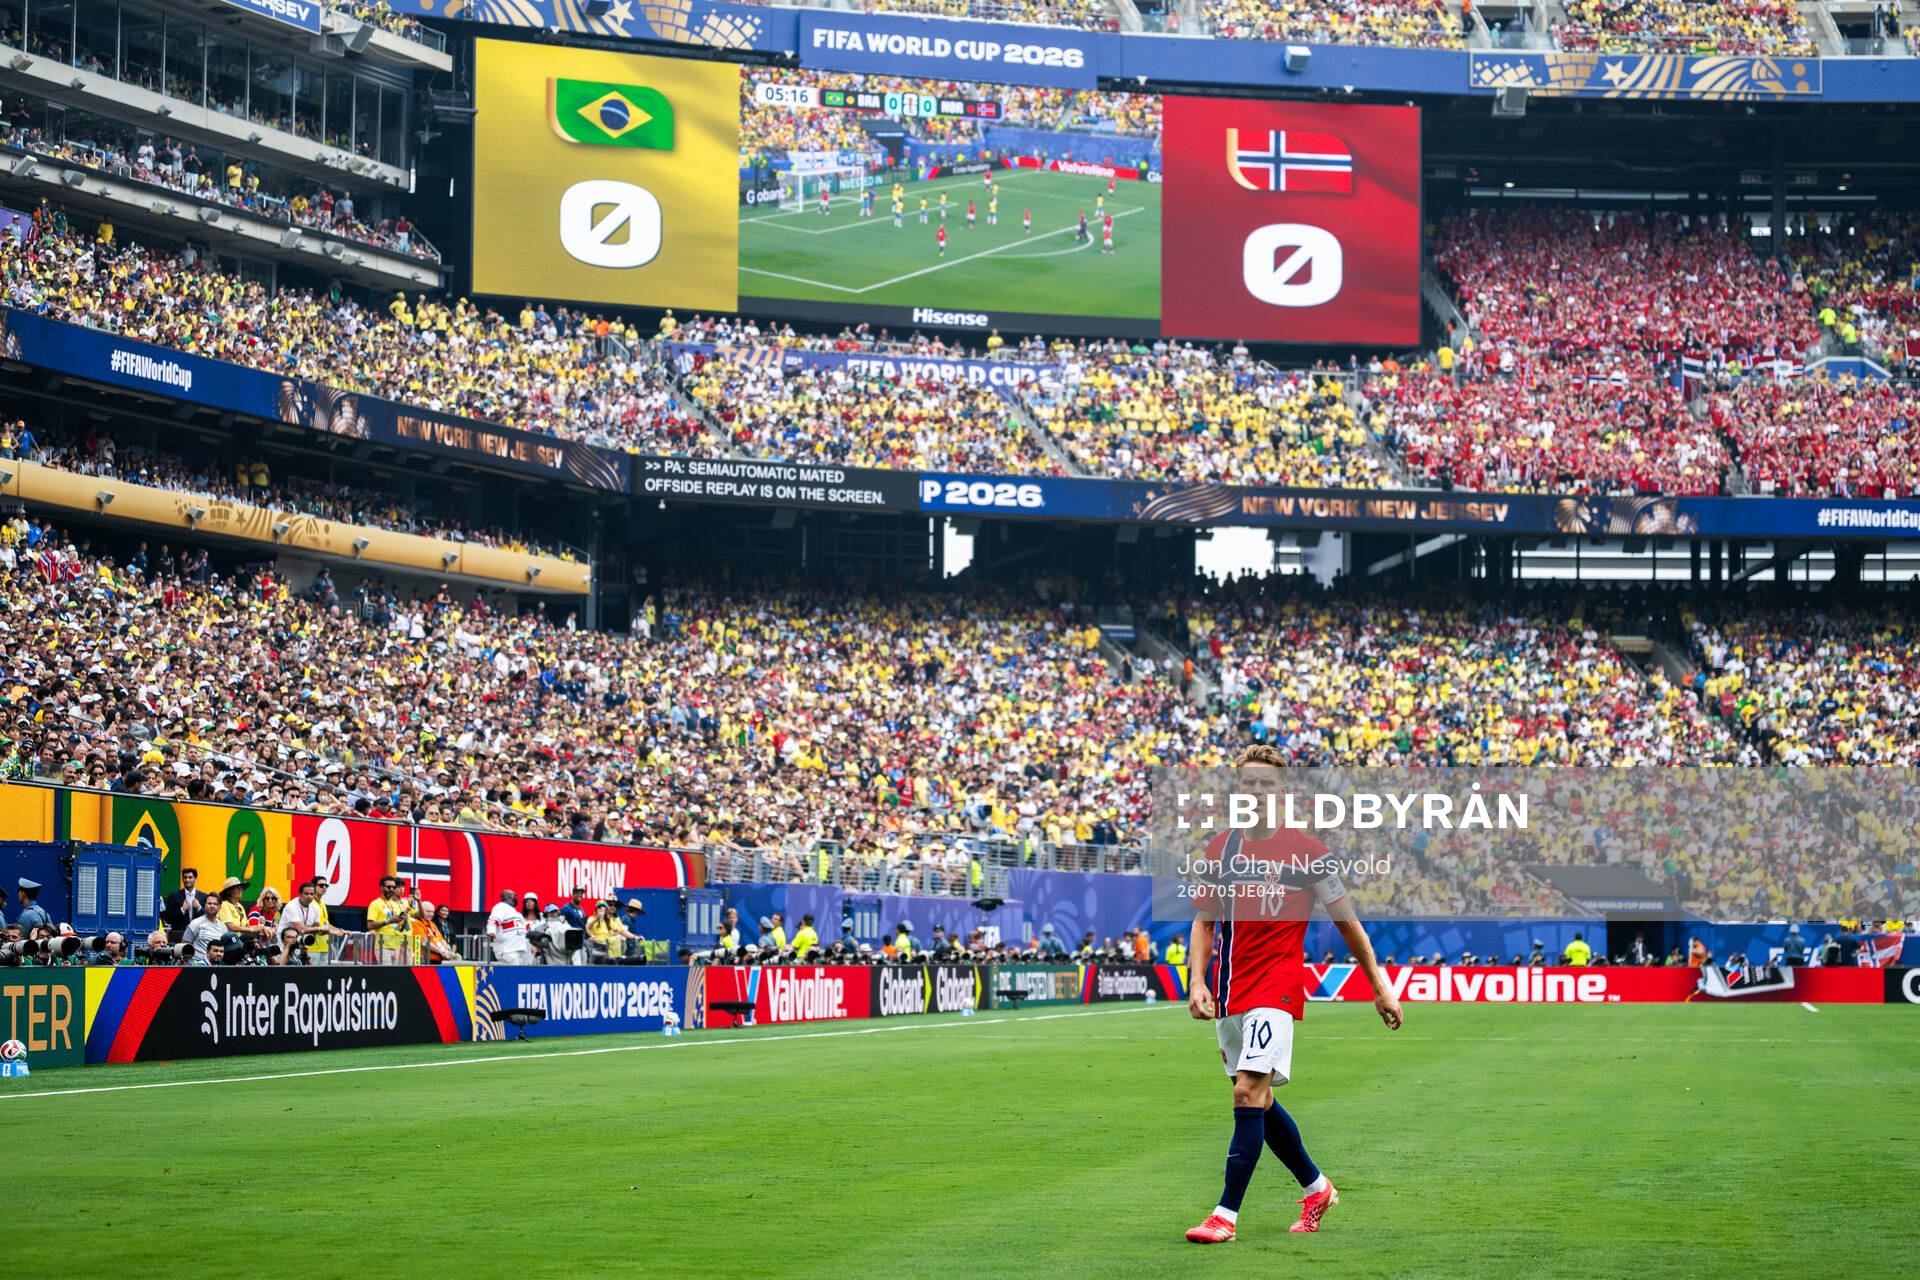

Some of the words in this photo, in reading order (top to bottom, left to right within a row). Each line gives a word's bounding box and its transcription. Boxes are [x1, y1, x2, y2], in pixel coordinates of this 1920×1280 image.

[812, 28, 864, 51] FIFA
[866, 32, 951, 58] WORLD
[954, 40, 1001, 62] CUP
[1003, 43, 1085, 68] 2026
[765, 87, 808, 103] 05:16
[857, 94, 880, 109] BRA
[889, 99, 898, 111] 0
[924, 103, 932, 113] 0
[940, 101, 964, 115] NOR
[1057, 160, 1116, 178] Valvoline
[746, 189, 787, 204] Gobant
[913, 307, 988, 327] Hisense
[111, 349, 192, 392] #FIFAWorldCup
[397, 416, 432, 441] NEW
[434, 423, 473, 449] YORK
[475, 434, 508, 458] NEW
[664, 461, 685, 474] PA:
[688, 462, 797, 481] SEMIAUTOMATIC
[799, 468, 845, 483] MATED
[645, 478, 703, 494] OFFSIDE
[706, 482, 758, 498] REPLAY
[760, 486, 773, 499] IS
[775, 487, 799, 500] ON
[799, 488, 833, 502] THE
[834, 490, 885, 505] SCREEN.
[945, 480, 1043, 508] 2026
[1242, 496, 1294, 517] NEW
[1298, 497, 1360, 519] YORK
[1365, 500, 1416, 520] NEW
[1420, 502, 1509, 523] JERSEY
[557, 857, 626, 901] NORWAY
[1260, 884, 1283, 917] 10
[517, 983, 549, 1020] FIFA
[550, 982, 599, 1020] WORLD
[600, 982, 627, 1019] CUP
[627, 981, 671, 1018] 2026
[766, 968, 844, 1022] Valvoline
[879, 967, 923, 1016] Globant
[936, 966, 975, 1013] Globant
[1377, 966, 1607, 1002] Valvoline
[226, 982, 279, 1037] Inter
[284, 976, 398, 1047] Rapidísimo
[1250, 1019, 1272, 1049] 10
